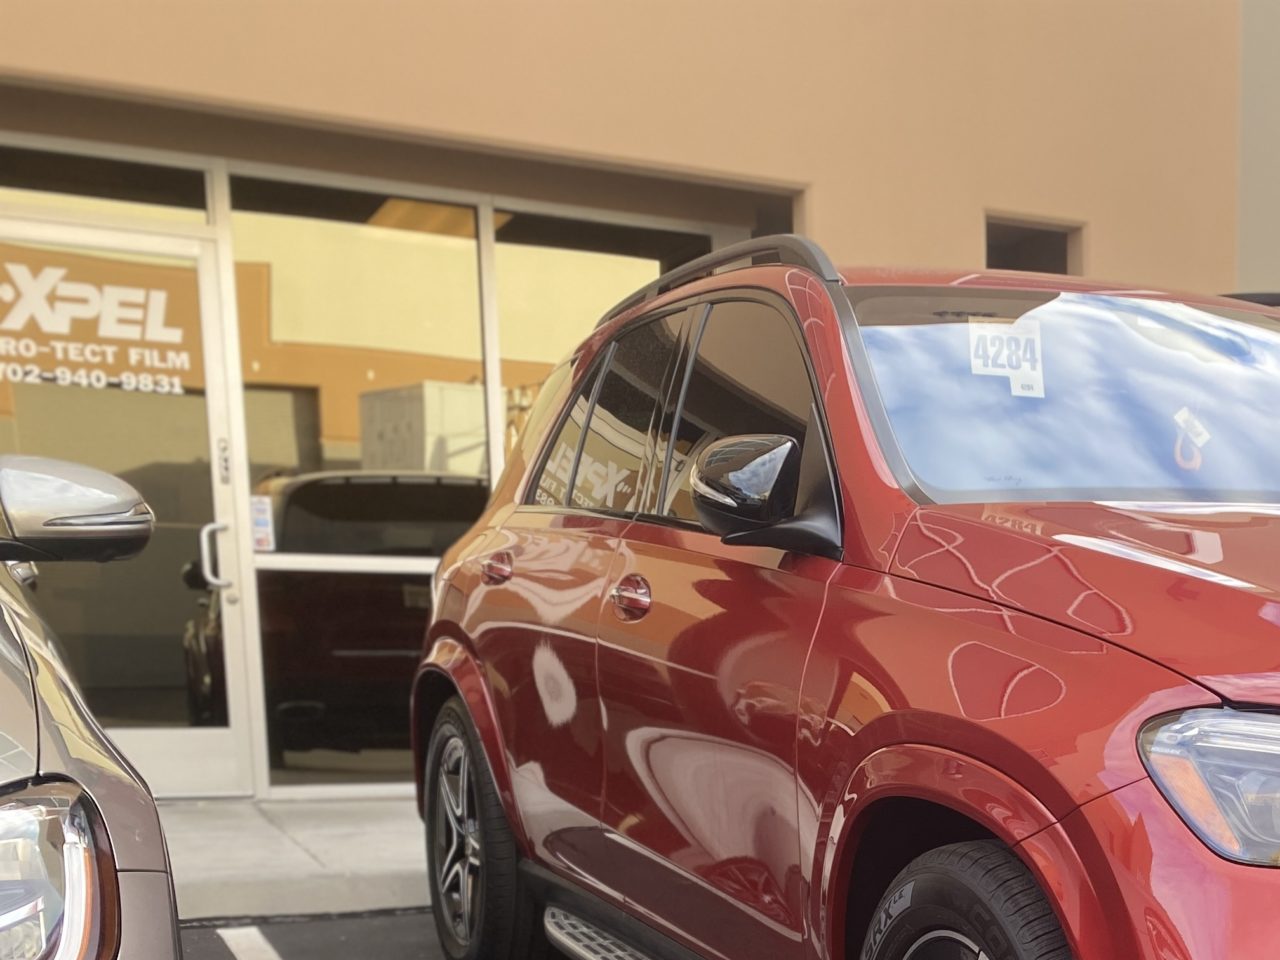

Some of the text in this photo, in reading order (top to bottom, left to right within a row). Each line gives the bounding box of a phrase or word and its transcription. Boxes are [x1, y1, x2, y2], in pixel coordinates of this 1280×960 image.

[1, 262, 183, 344] XPEL
[127, 346, 191, 371] FILM
[973, 333, 1038, 372] 4284
